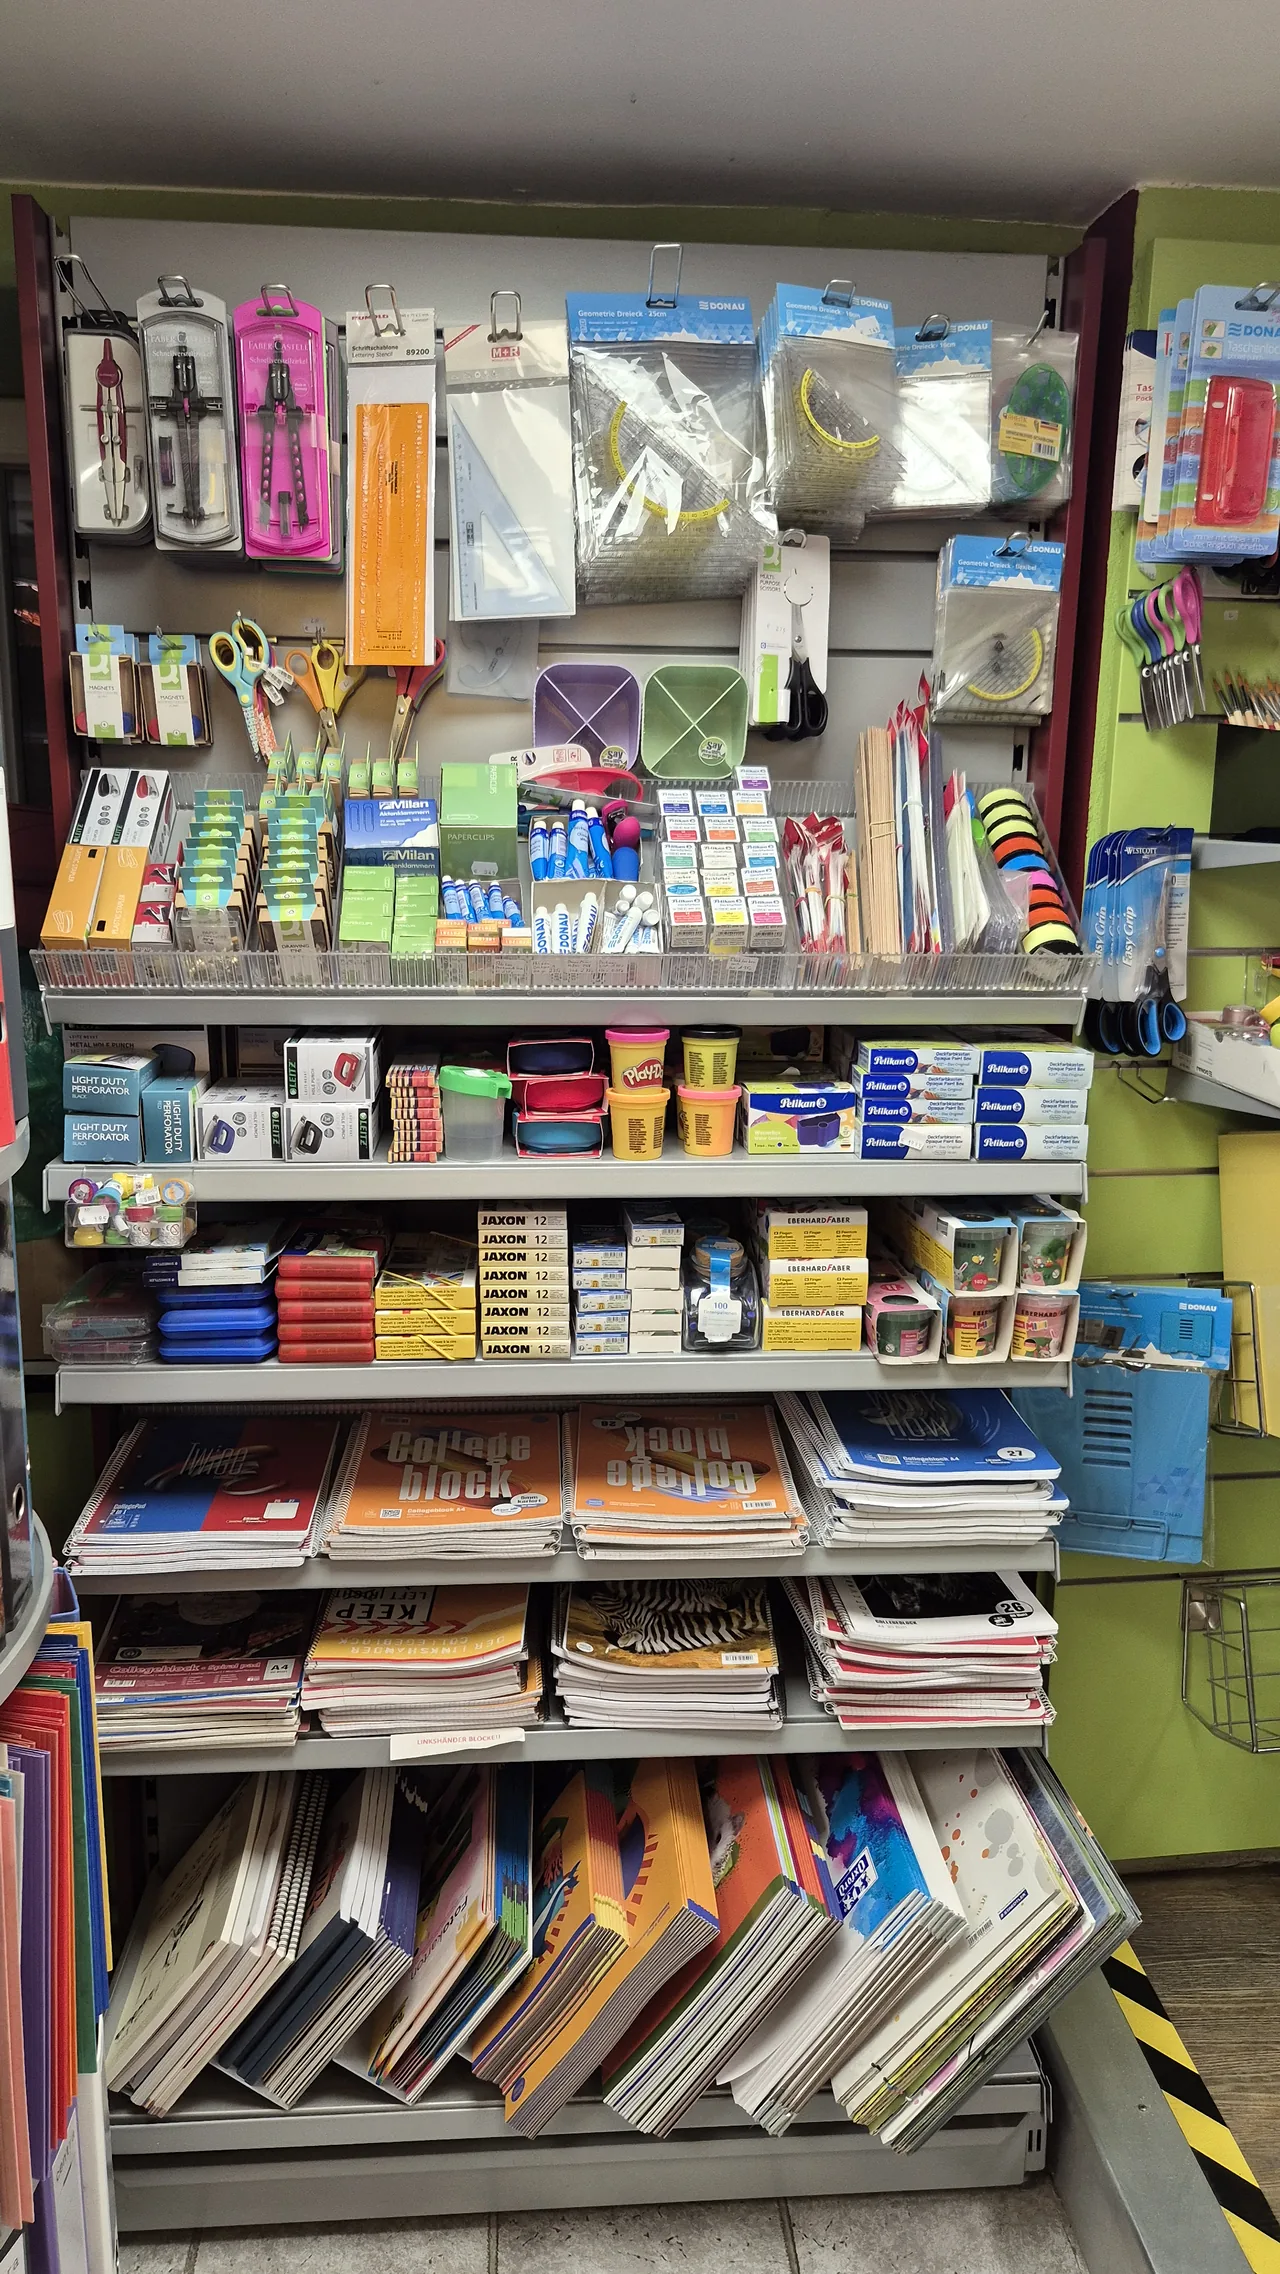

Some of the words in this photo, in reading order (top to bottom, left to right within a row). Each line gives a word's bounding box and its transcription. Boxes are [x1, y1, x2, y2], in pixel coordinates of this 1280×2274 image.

[710, 302, 745, 310] DONAU
[786, 302, 817, 312] Geometrie
[818, 305, 842, 314] Dreieck
[860, 299, 888, 310] DONAU
[578, 310, 614, 318] Geometrie
[957, 323, 988, 332] DONAU
[406, 348, 430, 356] 89200
[493, 347, 519, 358] M+R
[1033, 546, 1060, 554] DONAU
[958, 559, 988, 568] Geometrie
[990, 560, 1012, 569] Dreieck
[1014, 562, 1036, 572] flexibel
[706, 741, 723, 751] say
[608, 750, 623, 760] say
[392, 800, 430, 810] Milan
[395, 850, 434, 860] Milan
[1126, 846, 1158, 854] WESTCOTT
[586, 905, 598, 936] DONAU
[1124, 906, 1136, 936] Grip
[535, 918, 548, 954] DONAU
[559, 914, 570, 954] DONAU
[1122, 937, 1136, 967] Easy
[874, 1056, 904, 1066] Pelikan
[987, 1064, 1018, 1074] Pelikan
[289, 1061, 297, 1088] LEITZ
[72, 1076, 100, 1085] LIGHT
[101, 1077, 127, 1086] DUTY
[866, 1081, 897, 1090] Pelikan
[72, 1085, 130, 1095] PERFORATOR
[780, 1098, 816, 1108] Pelikan
[980, 1102, 1012, 1111] Pelikan
[172, 1100, 180, 1124] LIGHT
[868, 1106, 898, 1116] Pelikan
[72, 1123, 100, 1132] LIGHT
[102, 1123, 128, 1132] DUTY
[163, 1100, 173, 1155] PERFORATOR
[72, 1132, 130, 1142] PERFORATOR
[272, 1121, 280, 1145] LEITZ
[360, 1120, 368, 1146] LEITZ
[174, 1126, 182, 1152] DUTY
[866, 1138, 896, 1147] Pelikan
[984, 1138, 1014, 1147] Pelikan
[482, 1216, 526, 1225] JAXON
[534, 1216, 547, 1225] 12
[788, 1216, 850, 1224] EBERHARDFABER
[482, 1235, 526, 1244] JAXON
[534, 1235, 547, 1244] 12
[482, 1252, 527, 1262] JAXON
[535, 1252, 547, 1261] 12
[788, 1264, 851, 1272] EBERHARDFABER
[483, 1271, 527, 1280] JAXON
[536, 1271, 548, 1280] 12
[484, 1289, 528, 1298] JAXON
[536, 1289, 548, 1298] 12
[484, 1307, 529, 1316] JAXON
[536, 1307, 549, 1316] 12
[1188, 1303, 1217, 1312] DONAU
[782, 1309, 845, 1317] EBERHARDFABER
[484, 1326, 529, 1335] JAXON
[536, 1326, 549, 1335] 12
[486, 1344, 530, 1354] JAXON
[538, 1344, 550, 1353] 12
[387, 1430, 530, 1466] College
[624, 1426, 732, 1460] block
[398, 1462, 512, 1500] block
[607, 1456, 757, 1496] College
[336, 1604, 416, 1620] KEEP
[1001, 1602, 1025, 1614] 26
[109, 1664, 200, 1674] Collegeblock
[417, 1736, 466, 1745] LINKSHÄNDER
